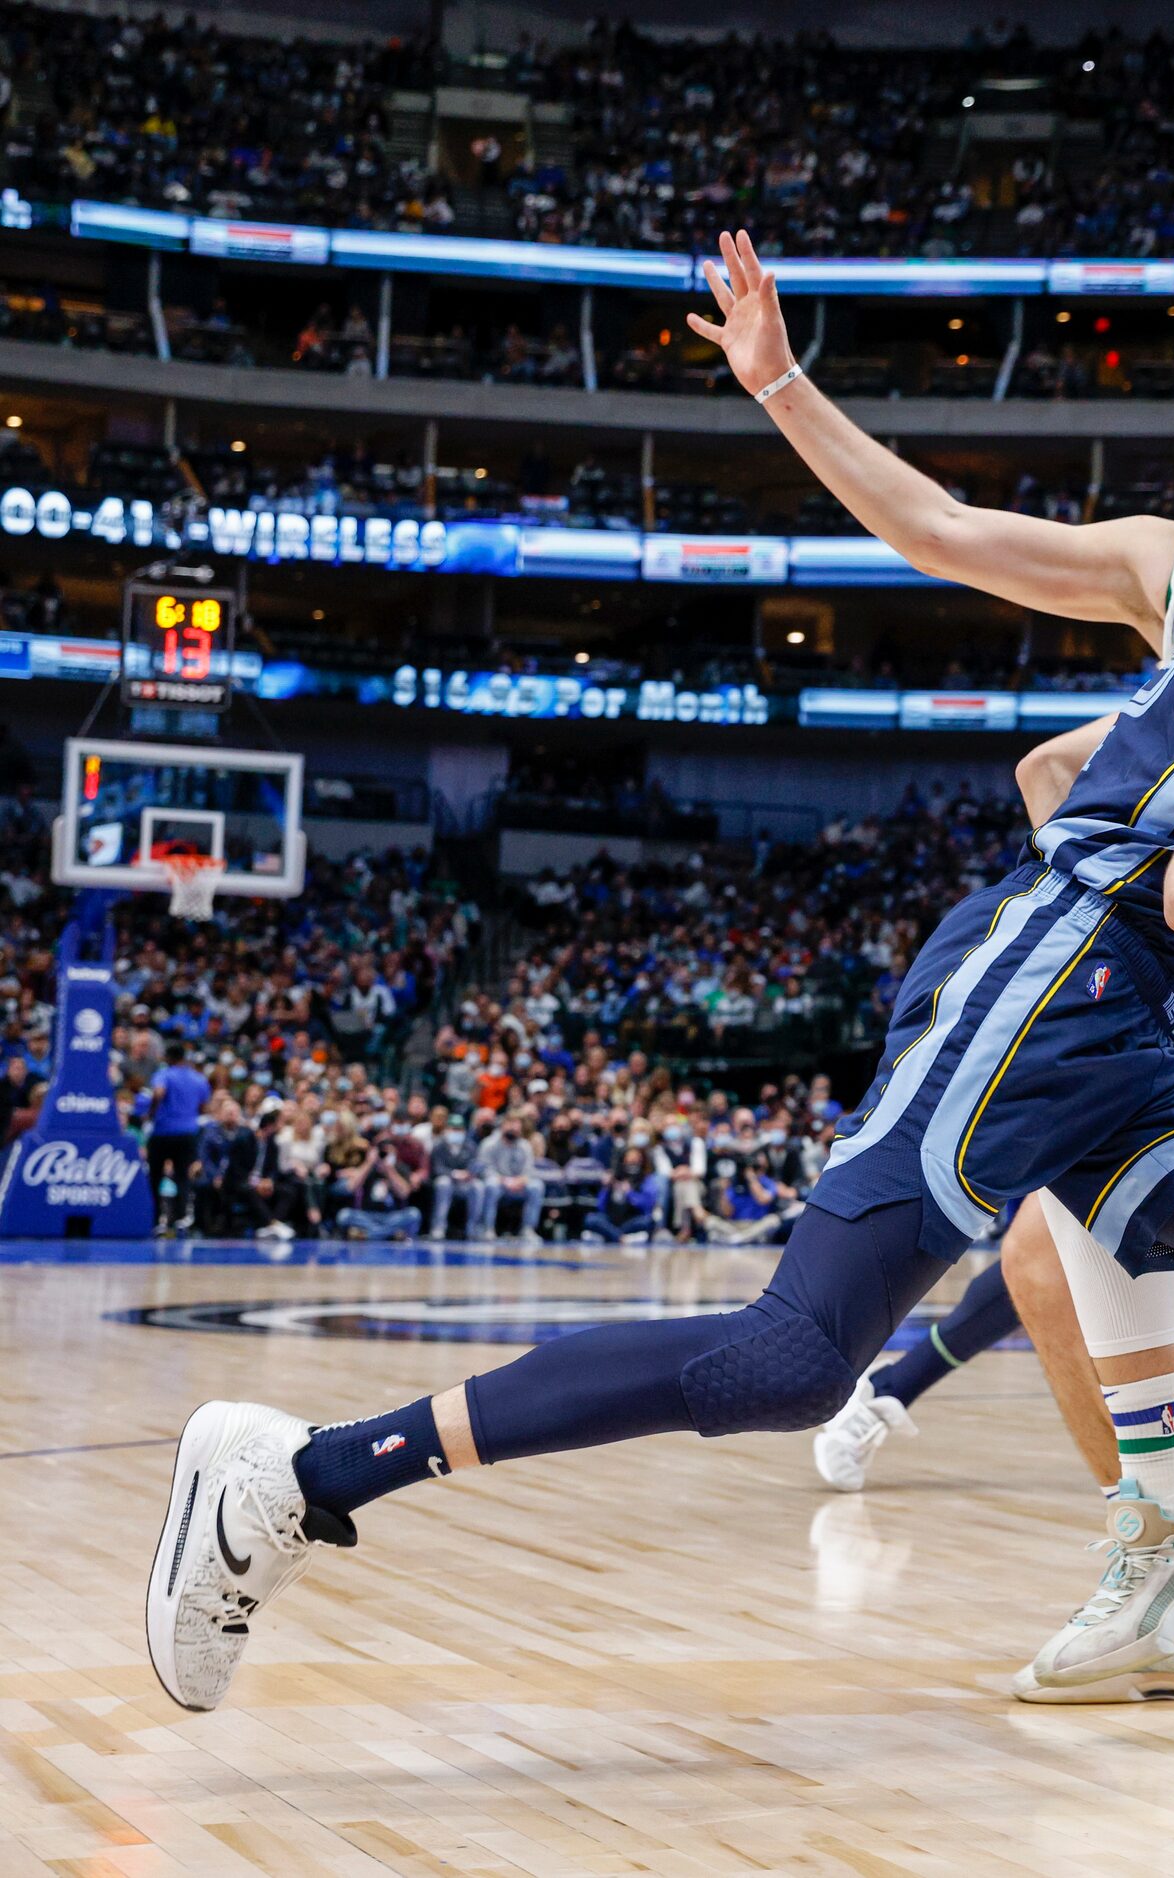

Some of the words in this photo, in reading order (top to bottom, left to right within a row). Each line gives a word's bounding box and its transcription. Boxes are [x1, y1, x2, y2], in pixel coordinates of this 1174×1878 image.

[164, 628, 212, 679] 13
[554, 677, 626, 718] Per
[637, 680, 768, 725] Month
[23, 1141, 141, 1198] Bally
[47, 1185, 111, 1207] SPORTS
